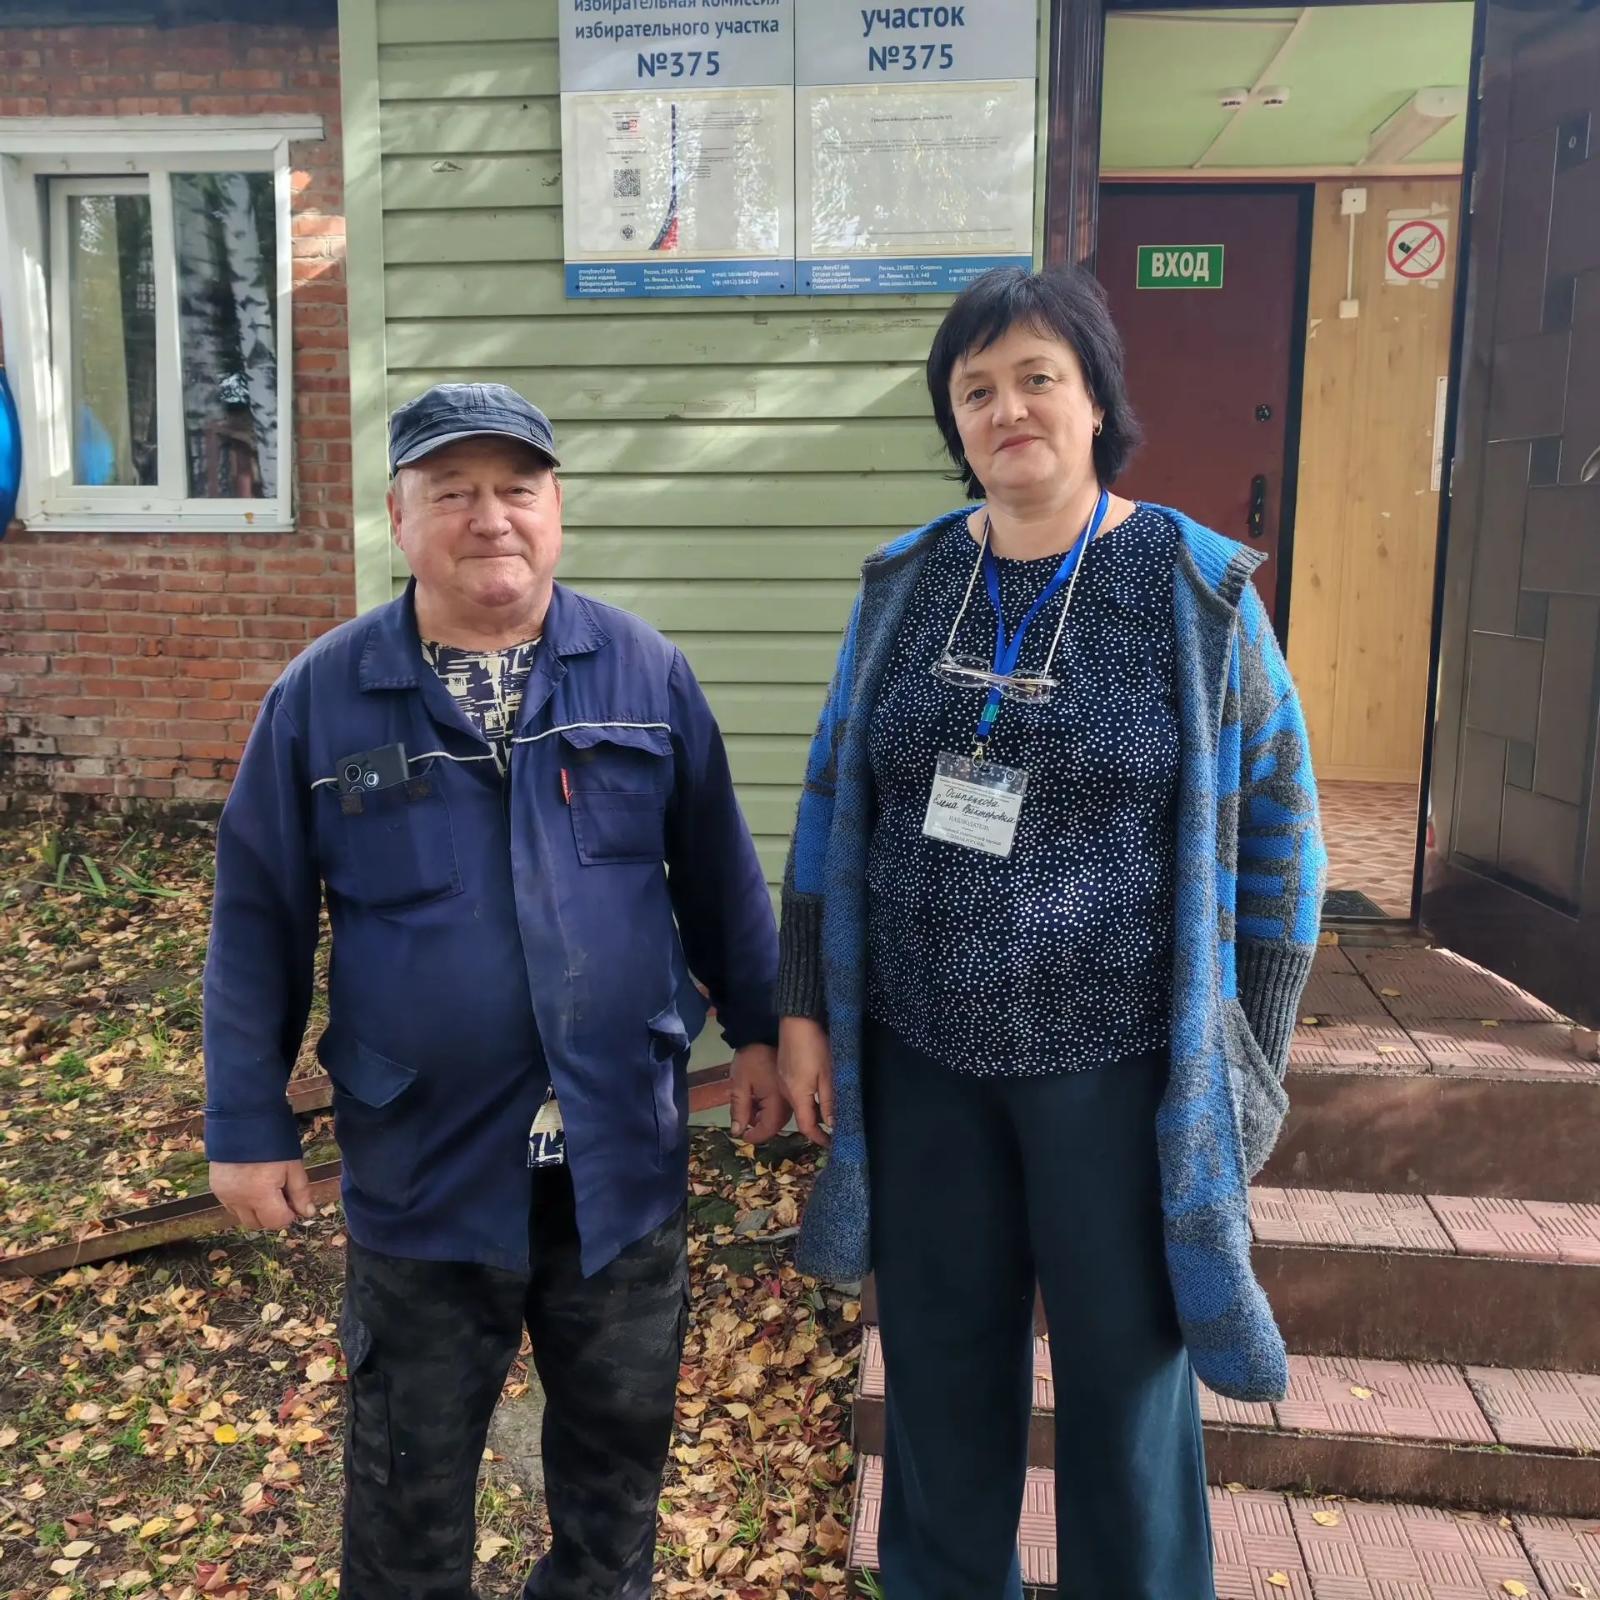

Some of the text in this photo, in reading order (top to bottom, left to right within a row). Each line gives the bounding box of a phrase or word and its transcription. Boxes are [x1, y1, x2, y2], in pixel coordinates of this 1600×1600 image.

[574, 0, 696, 15] избирательная
[575, 19, 779, 42] избирательного участка
[861, 6, 965, 37] участок
[637, 51, 720, 77] №375
[868, 43, 954, 71] №375
[1151, 252, 1210, 282] ВХОД
